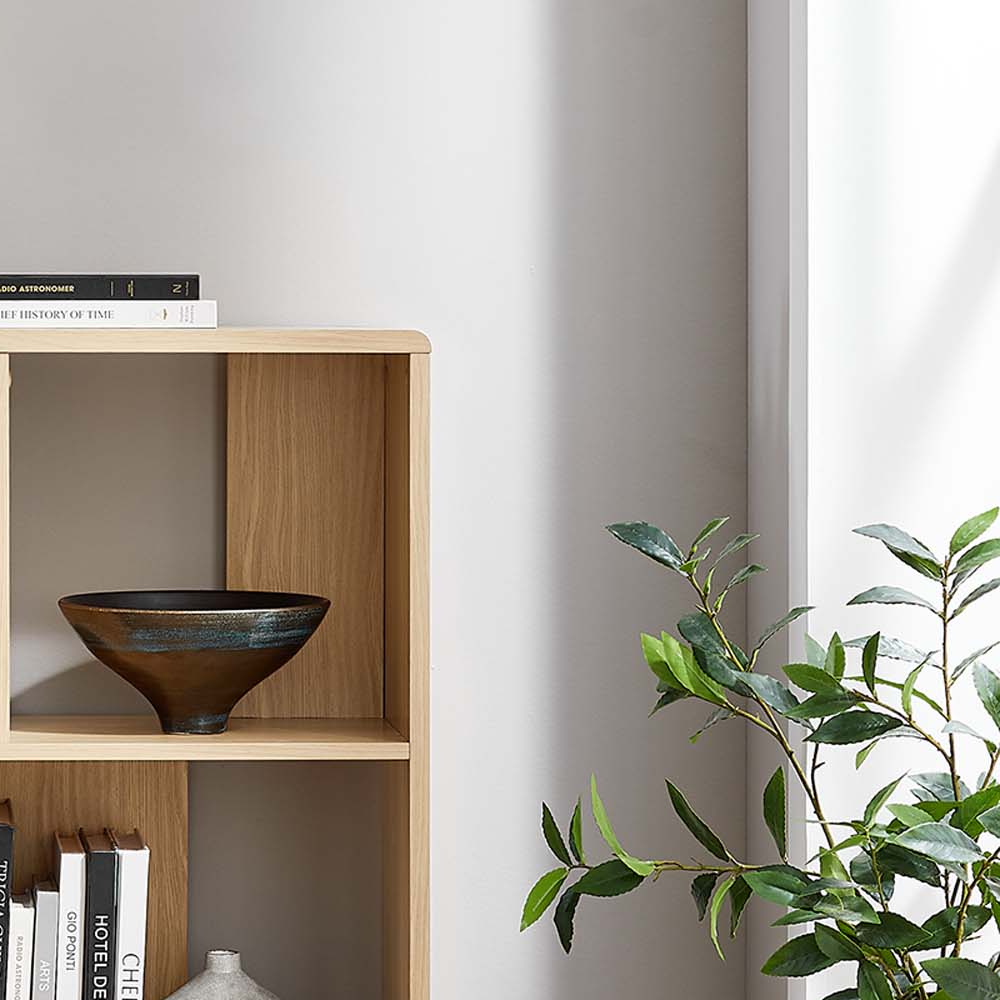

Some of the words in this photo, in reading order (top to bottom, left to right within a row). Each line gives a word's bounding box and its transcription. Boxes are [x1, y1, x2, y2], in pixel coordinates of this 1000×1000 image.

[19, 285, 75, 293] ASTRONOMER
[19, 310, 69, 320] HISTORY
[69, 310, 85, 320] OF
[87, 310, 115, 320] TIME
[66, 911, 77, 933] GIO
[15, 935, 23, 962] RADIO
[65, 935, 77, 971] PONTI
[94, 915, 109, 973] HOTEL
[39, 959, 50, 991] ARTS
